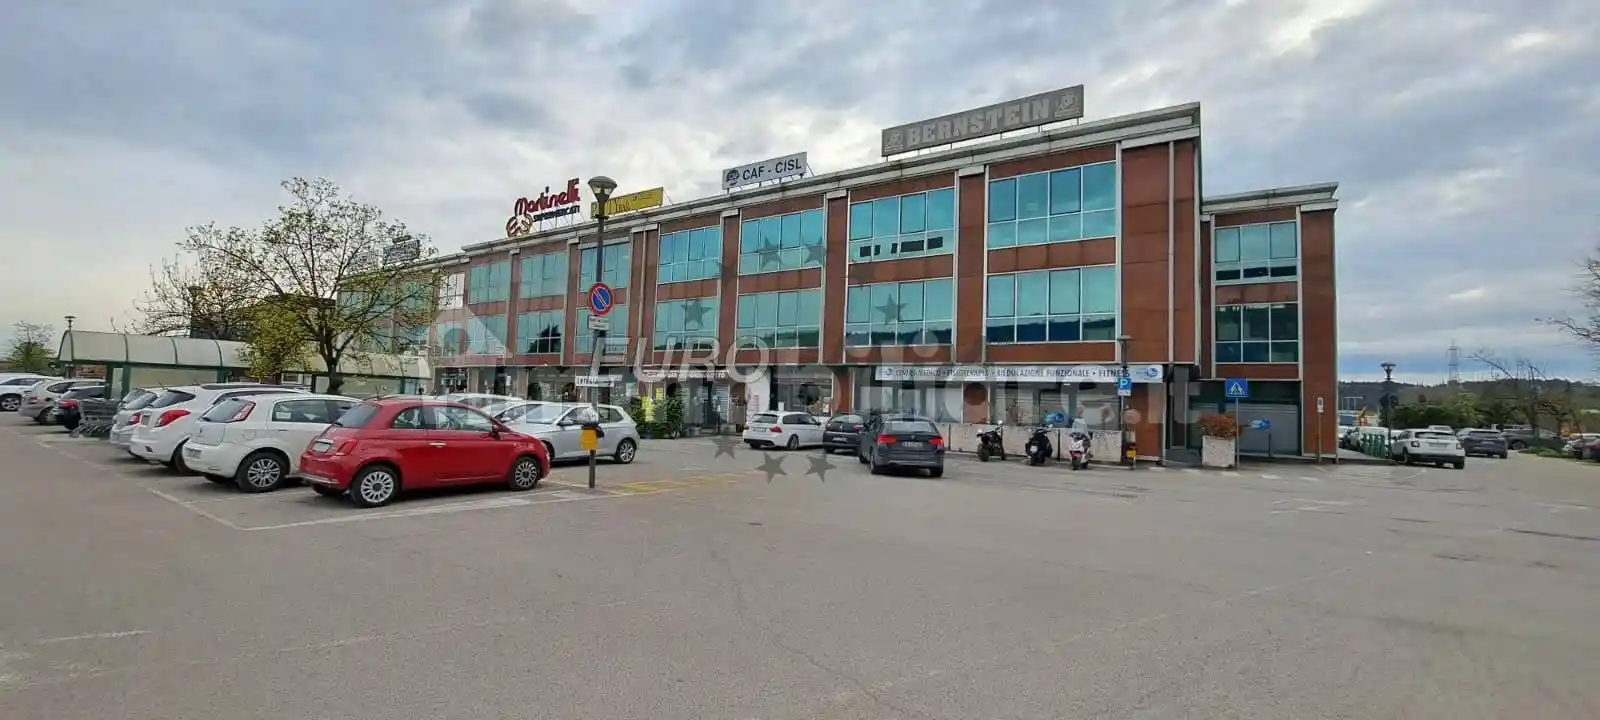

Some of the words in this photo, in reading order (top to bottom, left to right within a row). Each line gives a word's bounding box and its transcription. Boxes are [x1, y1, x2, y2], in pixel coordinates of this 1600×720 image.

[906, 100, 1050, 147] BERNSTEIN
[742, 165, 765, 180] CAF
[775, 158, 802, 174] CISL
[514, 177, 580, 216] Martinelli
[1046, 369, 1089, 377] FUNZIONALE
[1119, 378, 1129, 389] P
